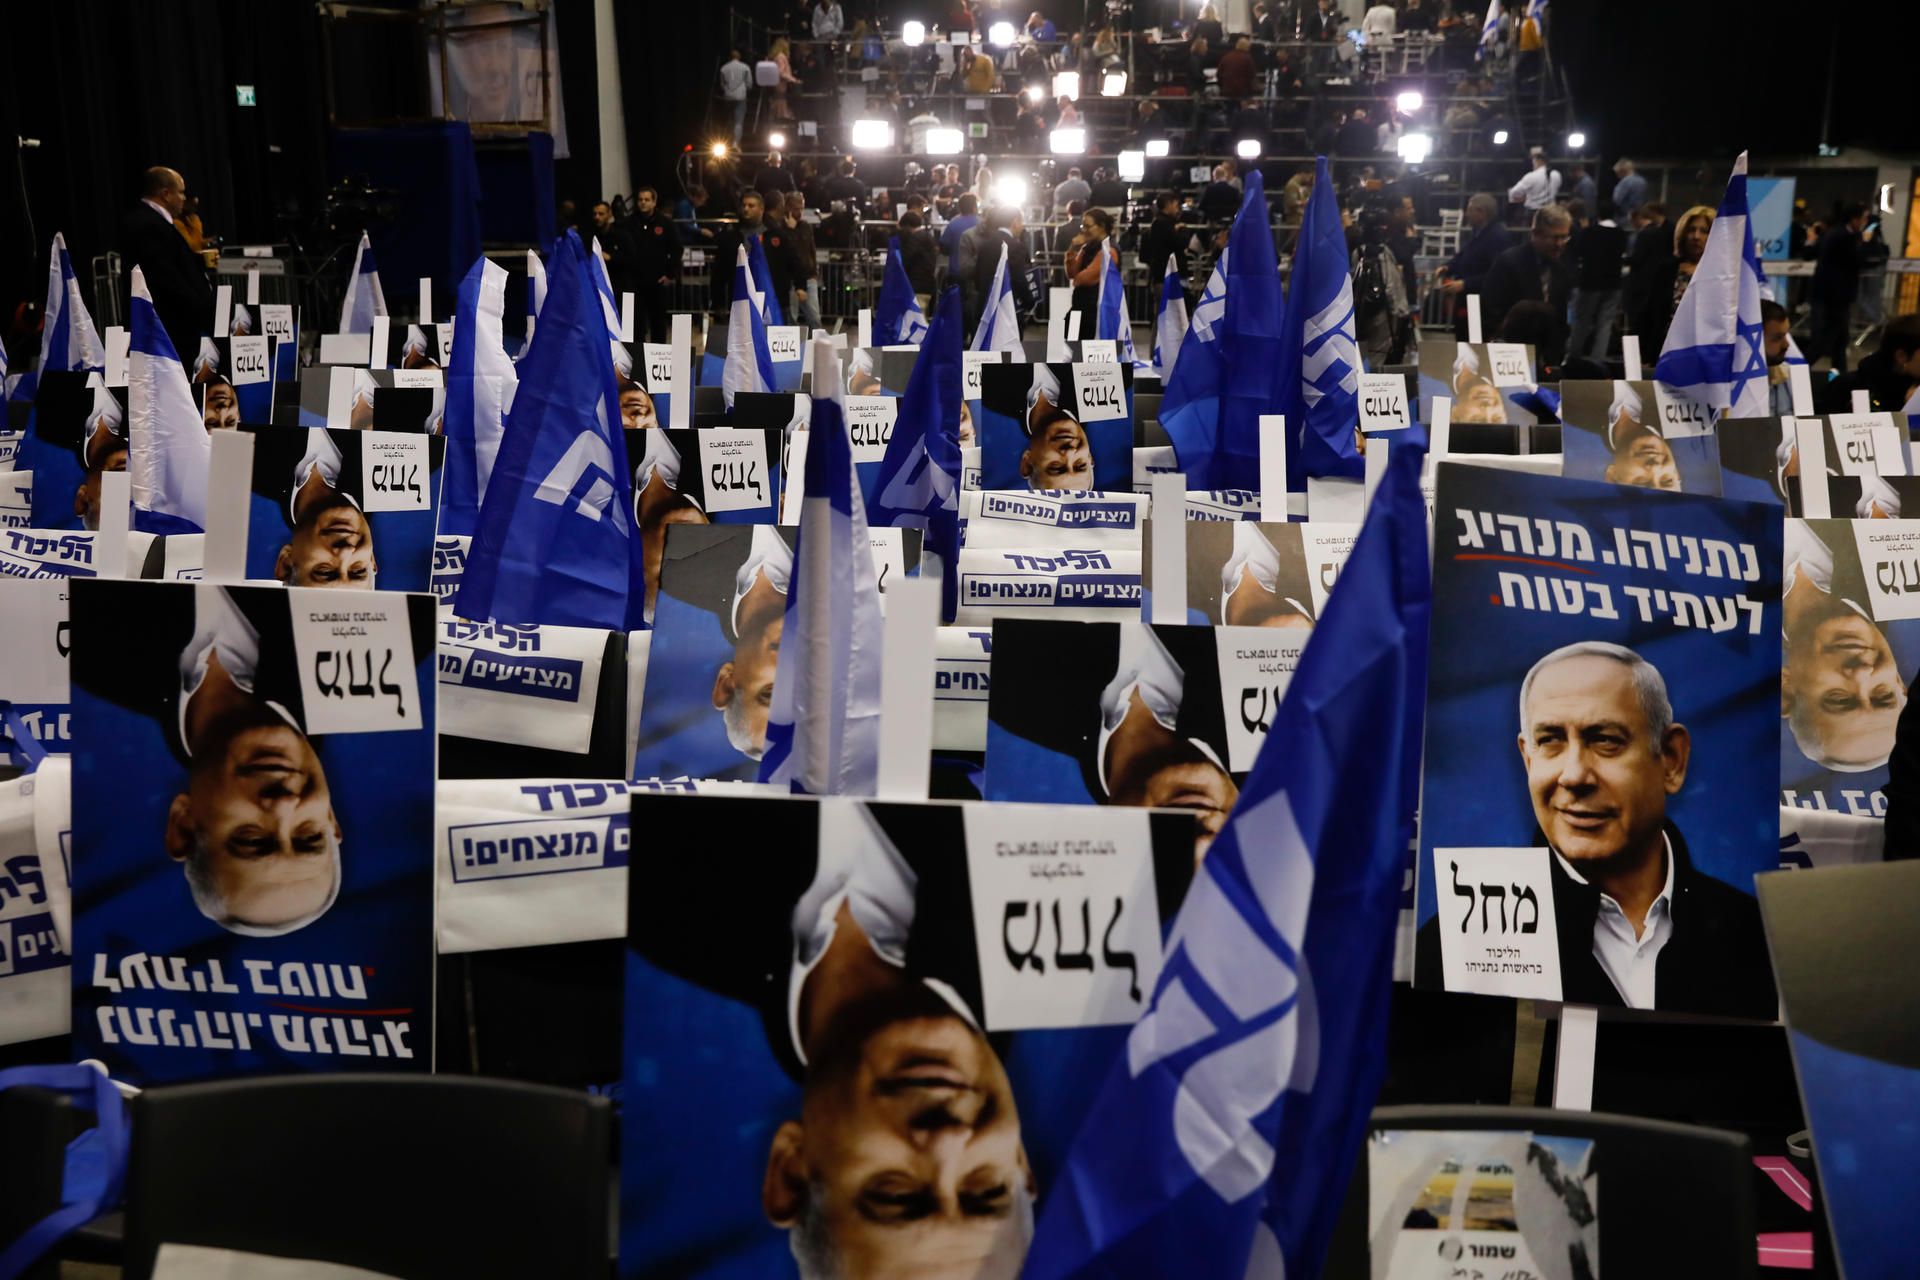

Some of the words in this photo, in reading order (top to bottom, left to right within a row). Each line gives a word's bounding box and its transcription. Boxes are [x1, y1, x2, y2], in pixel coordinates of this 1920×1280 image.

[236, 355, 265, 377] מחל
[1083, 385, 1121, 413] מחל
[1365, 396, 1404, 423] מחל
[372, 464, 422, 503] מחל
[711, 461, 763, 501] מחל
[988, 497, 1056, 520] מנצחים!
[1062, 511, 1131, 523] מצביעים
[6, 531, 95, 564] הליכוד
[1455, 509, 1596, 563] מנהיג
[1003, 549, 1112, 572] הליכוד
[1602, 527, 1761, 582] נתניהו.
[970, 580, 1052, 598] מנצחים!
[1061, 583, 1142, 599] מצביעים
[1877, 559, 1920, 596] מח
[1490, 571, 1619, 620] בטוח.
[1624, 586, 1763, 635] לעתיד
[315, 648, 406, 718] מחל
[471, 659, 573, 691] מצביעים
[463, 830, 599, 867] מנצחים!
[1450, 860, 1540, 934] מחל
[1003, 896, 1142, 1003] מחל
[1486, 945, 1521, 959] הליכוד
[92, 951, 240, 994] לעתיד
[1465, 961, 1499, 974] נתניהו
[1502, 961, 1543, 975] בראשות
[268, 1013, 414, 1059] מנהיג
